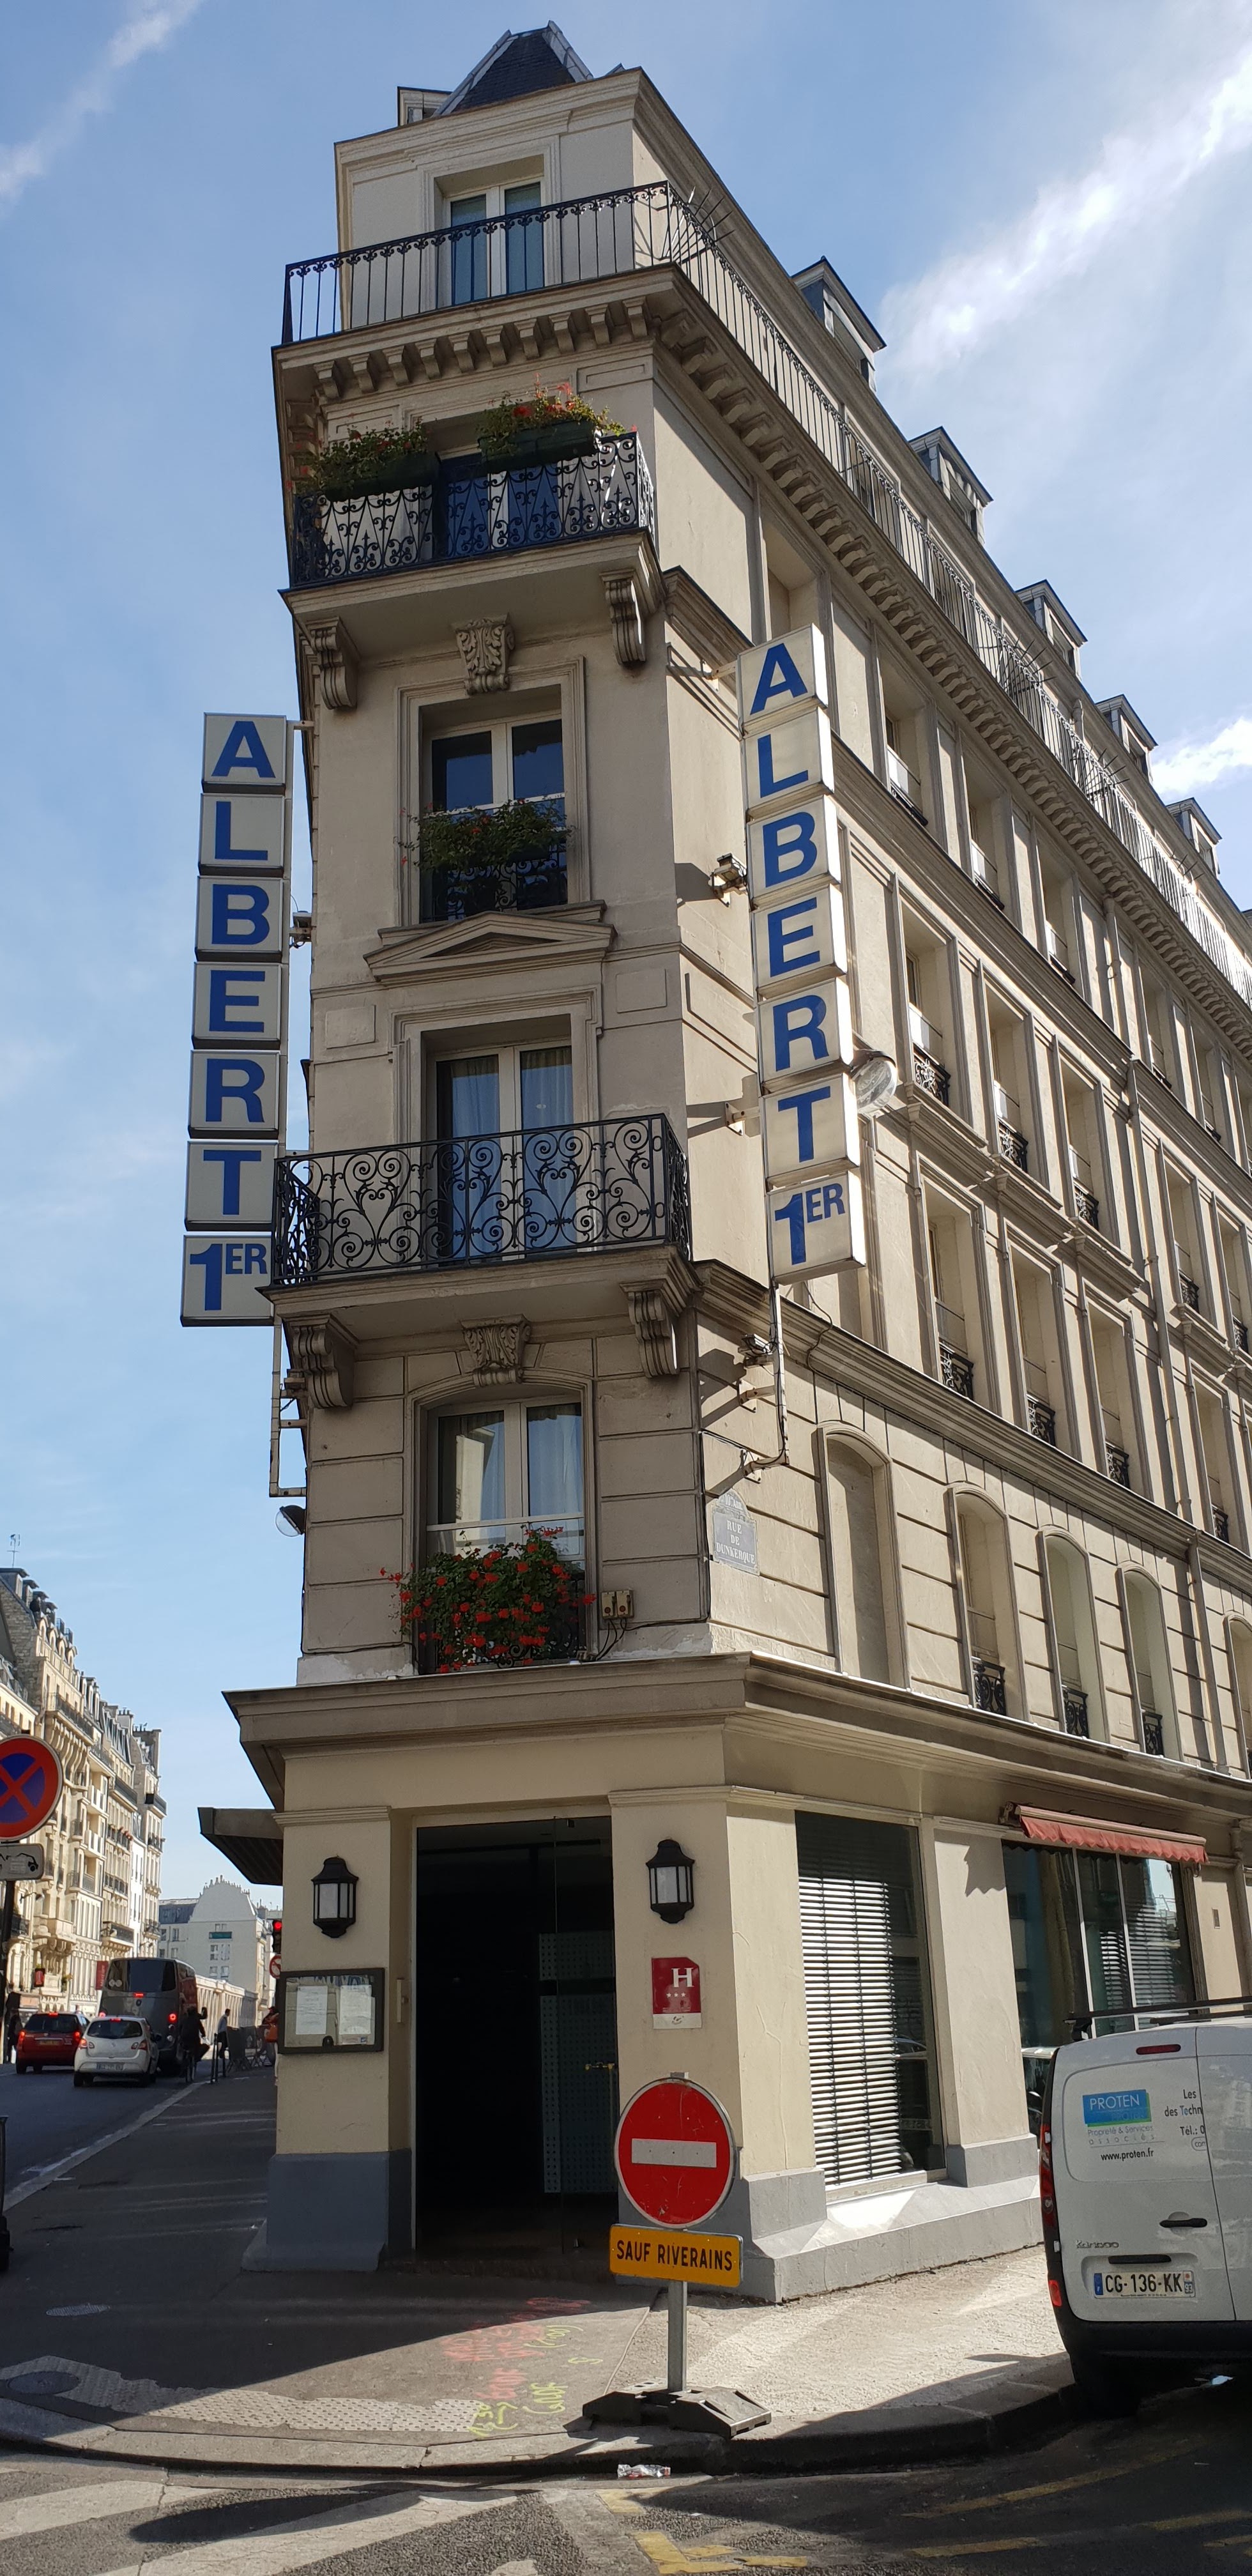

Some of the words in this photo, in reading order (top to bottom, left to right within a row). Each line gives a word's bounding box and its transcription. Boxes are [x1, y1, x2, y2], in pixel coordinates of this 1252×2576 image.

[751, 643, 830, 1163] ALBERT
[203, 720, 275, 1215] ALBERT
[726, 1520, 742, 1534] RUE
[730, 1535, 740, 1545] DE
[715, 1542, 756, 1564] DUNKERQUE
[671, 1967, 695, 1988] H
[1183, 2089, 1197, 2099] Les
[1089, 2094, 1140, 2111] PROTEN
[1164, 2105, 1178, 2117] des
[1125, 2125, 1154, 2134] Services
[1101, 2147, 1154, 2161] www.proten.fr
[616, 2239, 651, 2262] SAUF
[657, 2244, 733, 2271] RIVERAINS
[1105, 2273, 1183, 2293] CG-136-KK
[1184, 2283, 1193, 2294] 93
